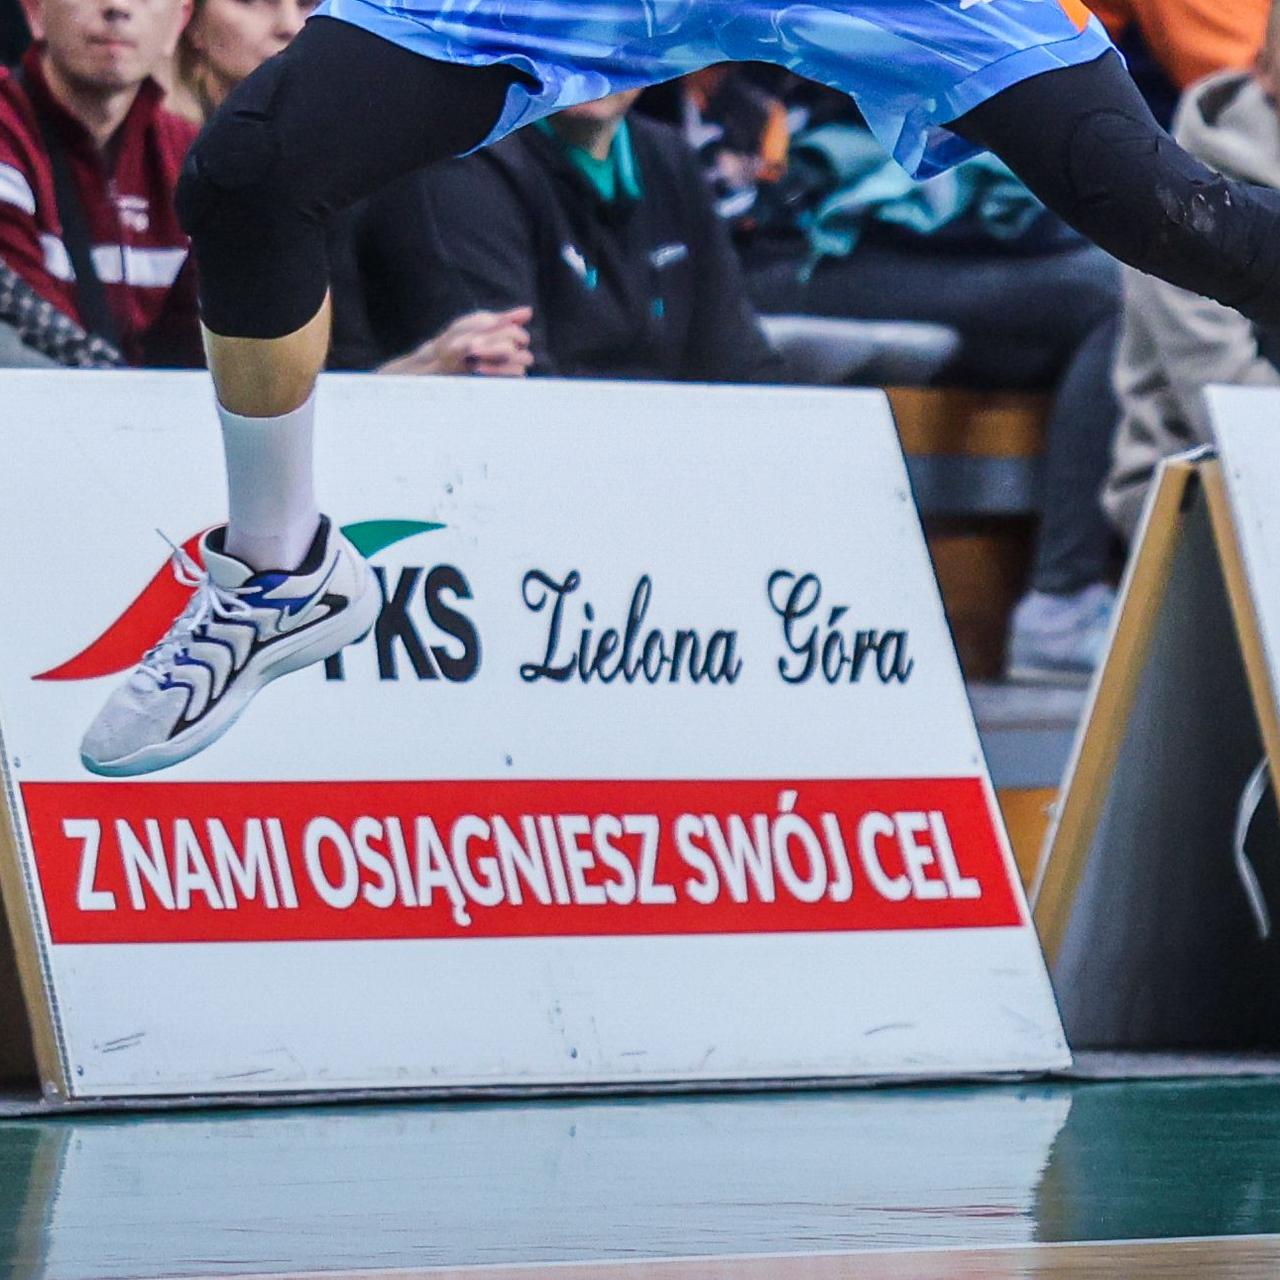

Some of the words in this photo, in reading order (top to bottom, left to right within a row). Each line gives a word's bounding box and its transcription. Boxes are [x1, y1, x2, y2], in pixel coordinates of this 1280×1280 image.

[324, 563, 483, 683] KS
[519, 568, 743, 686] Zielona
[766, 569, 915, 686] Góra
[62, 819, 116, 911] Z
[116, 818, 298, 910] NAMI
[304, 814, 677, 926] OSIĄGNIESZ
[675, 790, 853, 904] SWÓJ
[858, 810, 981, 901] CEL
